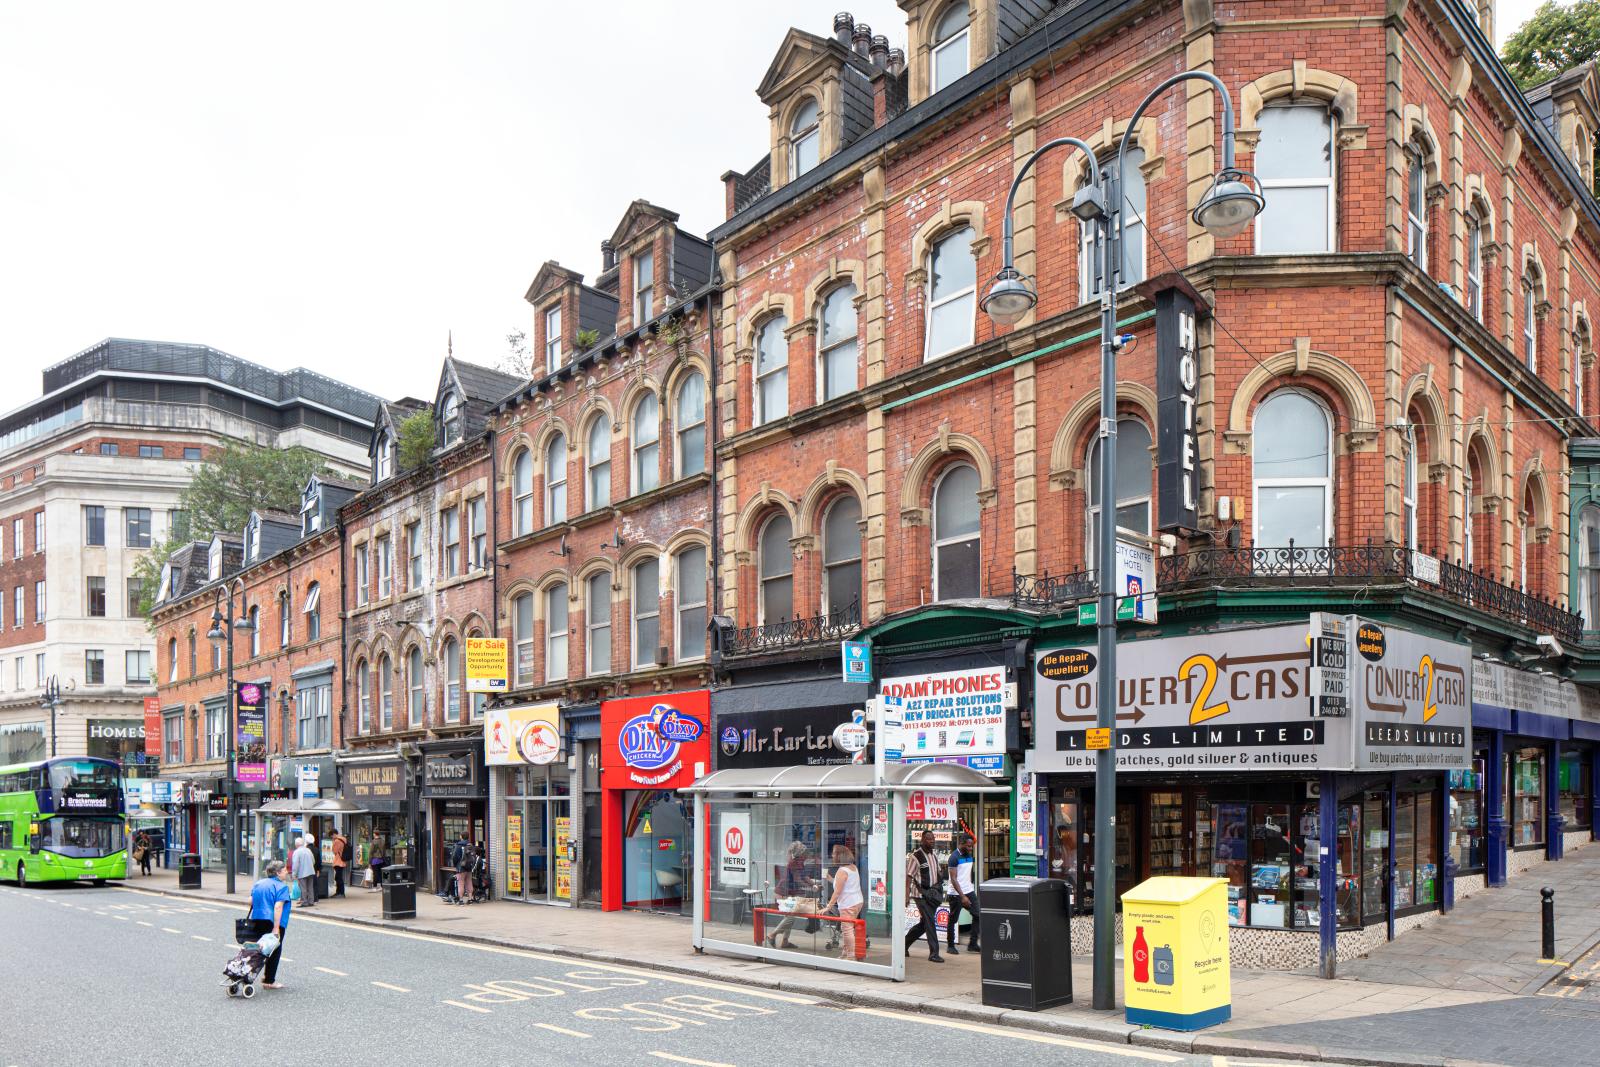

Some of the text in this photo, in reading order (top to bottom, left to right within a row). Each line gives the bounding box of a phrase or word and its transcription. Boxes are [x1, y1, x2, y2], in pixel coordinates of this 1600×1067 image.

[1179, 311, 1197, 512] HOTEL
[1129, 549, 1152, 563] CENTRE
[1124, 559, 1144, 572] HOTEL
[1360, 629, 1382, 640] We Repair
[468, 640, 505, 650] For Sale
[1322, 638, 1345, 651] WE BUY
[1360, 642, 1382, 656] Jewellery
[1044, 652, 1088, 666] We Repair
[1322, 652, 1344, 667] GOLD
[1043, 662, 1089, 677] Jewellery
[1322, 670, 1330, 679] TOP
[932, 674, 1000, 696] PHONES
[1056, 674, 1198, 710] COVERT
[1178, 653, 1230, 726] 2
[1324, 680, 1343, 693] PAID
[1366, 664, 1426, 703] CONVERT
[1419, 654, 1437, 724] 2
[1436, 676, 1464, 706] CASH
[906, 693, 1001, 710] A2Z REPAIR SOLUTIONS
[1327, 697, 1339, 705] 0113
[905, 710, 924, 721] NEW
[967, 706, 982, 717] LS2
[985, 705, 1001, 715] 8JD
[90, 726, 145, 738] HOMES
[666, 720, 695, 736] Dixy
[1070, 728, 1314, 748] LDS LIMITED
[1370, 728, 1462, 744] LEEDS LIMITED
[588, 753, 598, 768] 41
[1066, 756, 1083, 766] We
[1085, 756, 1096, 766] bu
[1168, 754, 1194, 766] gold
[1198, 752, 1236, 765] silver
[1239, 752, 1250, 764] &
[1253, 752, 1318, 766] antiques
[1370, 752, 1378, 763] We
[1380, 752, 1390, 766] buy
[1390, 752, 1414, 765] watches,
[1416, 754, 1426, 766] gold
[1427, 754, 1440, 764] silver
[1444, 755, 1463, 767] antiques
[350, 766, 397, 784] ULTIMATE SKIN
[631, 772, 643, 783] Love
[61, 798, 65, 806] 3
[929, 796, 948, 805] Phone
[950, 796, 954, 806] 6
[862, 815, 870, 825] 47
[930, 807, 947, 819] £99
[728, 832, 740, 848] M
[724, 857, 746, 865] METRO
[1194, 959, 1211, 968] Recycle
[573, 995, 778, 1032] BUS
